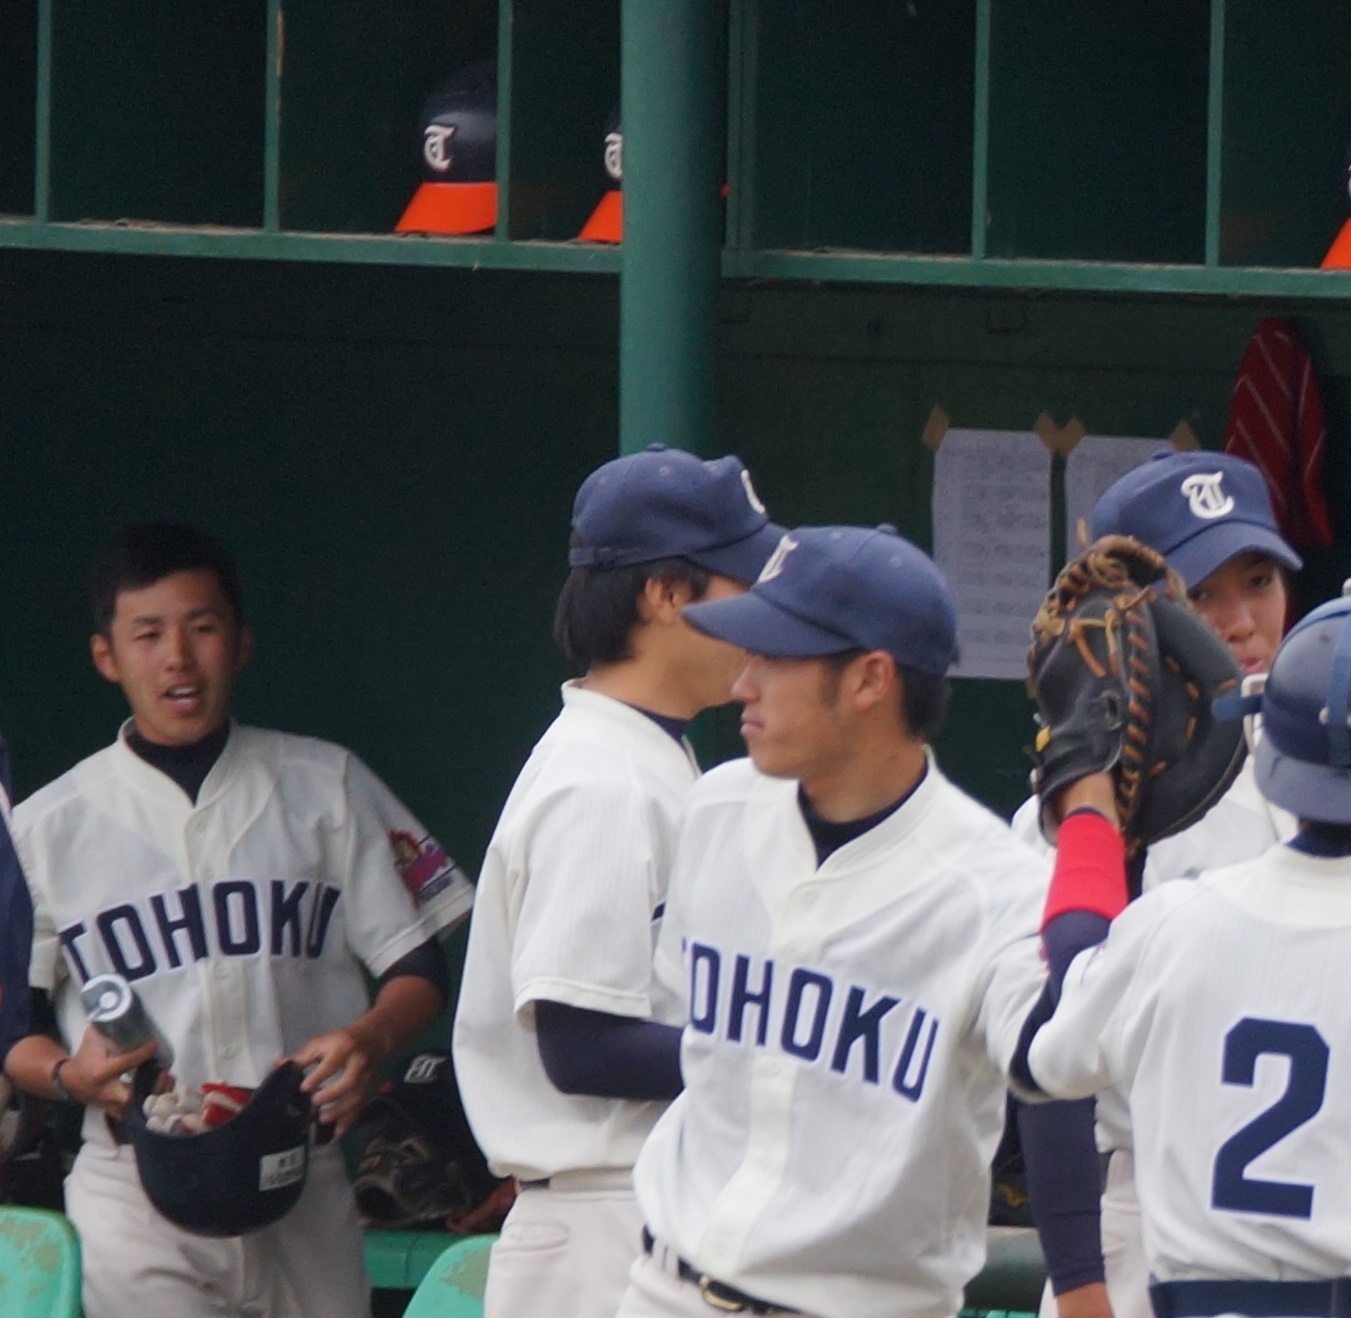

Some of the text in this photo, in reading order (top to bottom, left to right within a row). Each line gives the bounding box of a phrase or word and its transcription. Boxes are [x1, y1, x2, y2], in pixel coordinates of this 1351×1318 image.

[58, 880, 342, 983] TOHOKU
[682, 938, 940, 1104] OHOKU
[1211, 1016, 1331, 1221] 2
